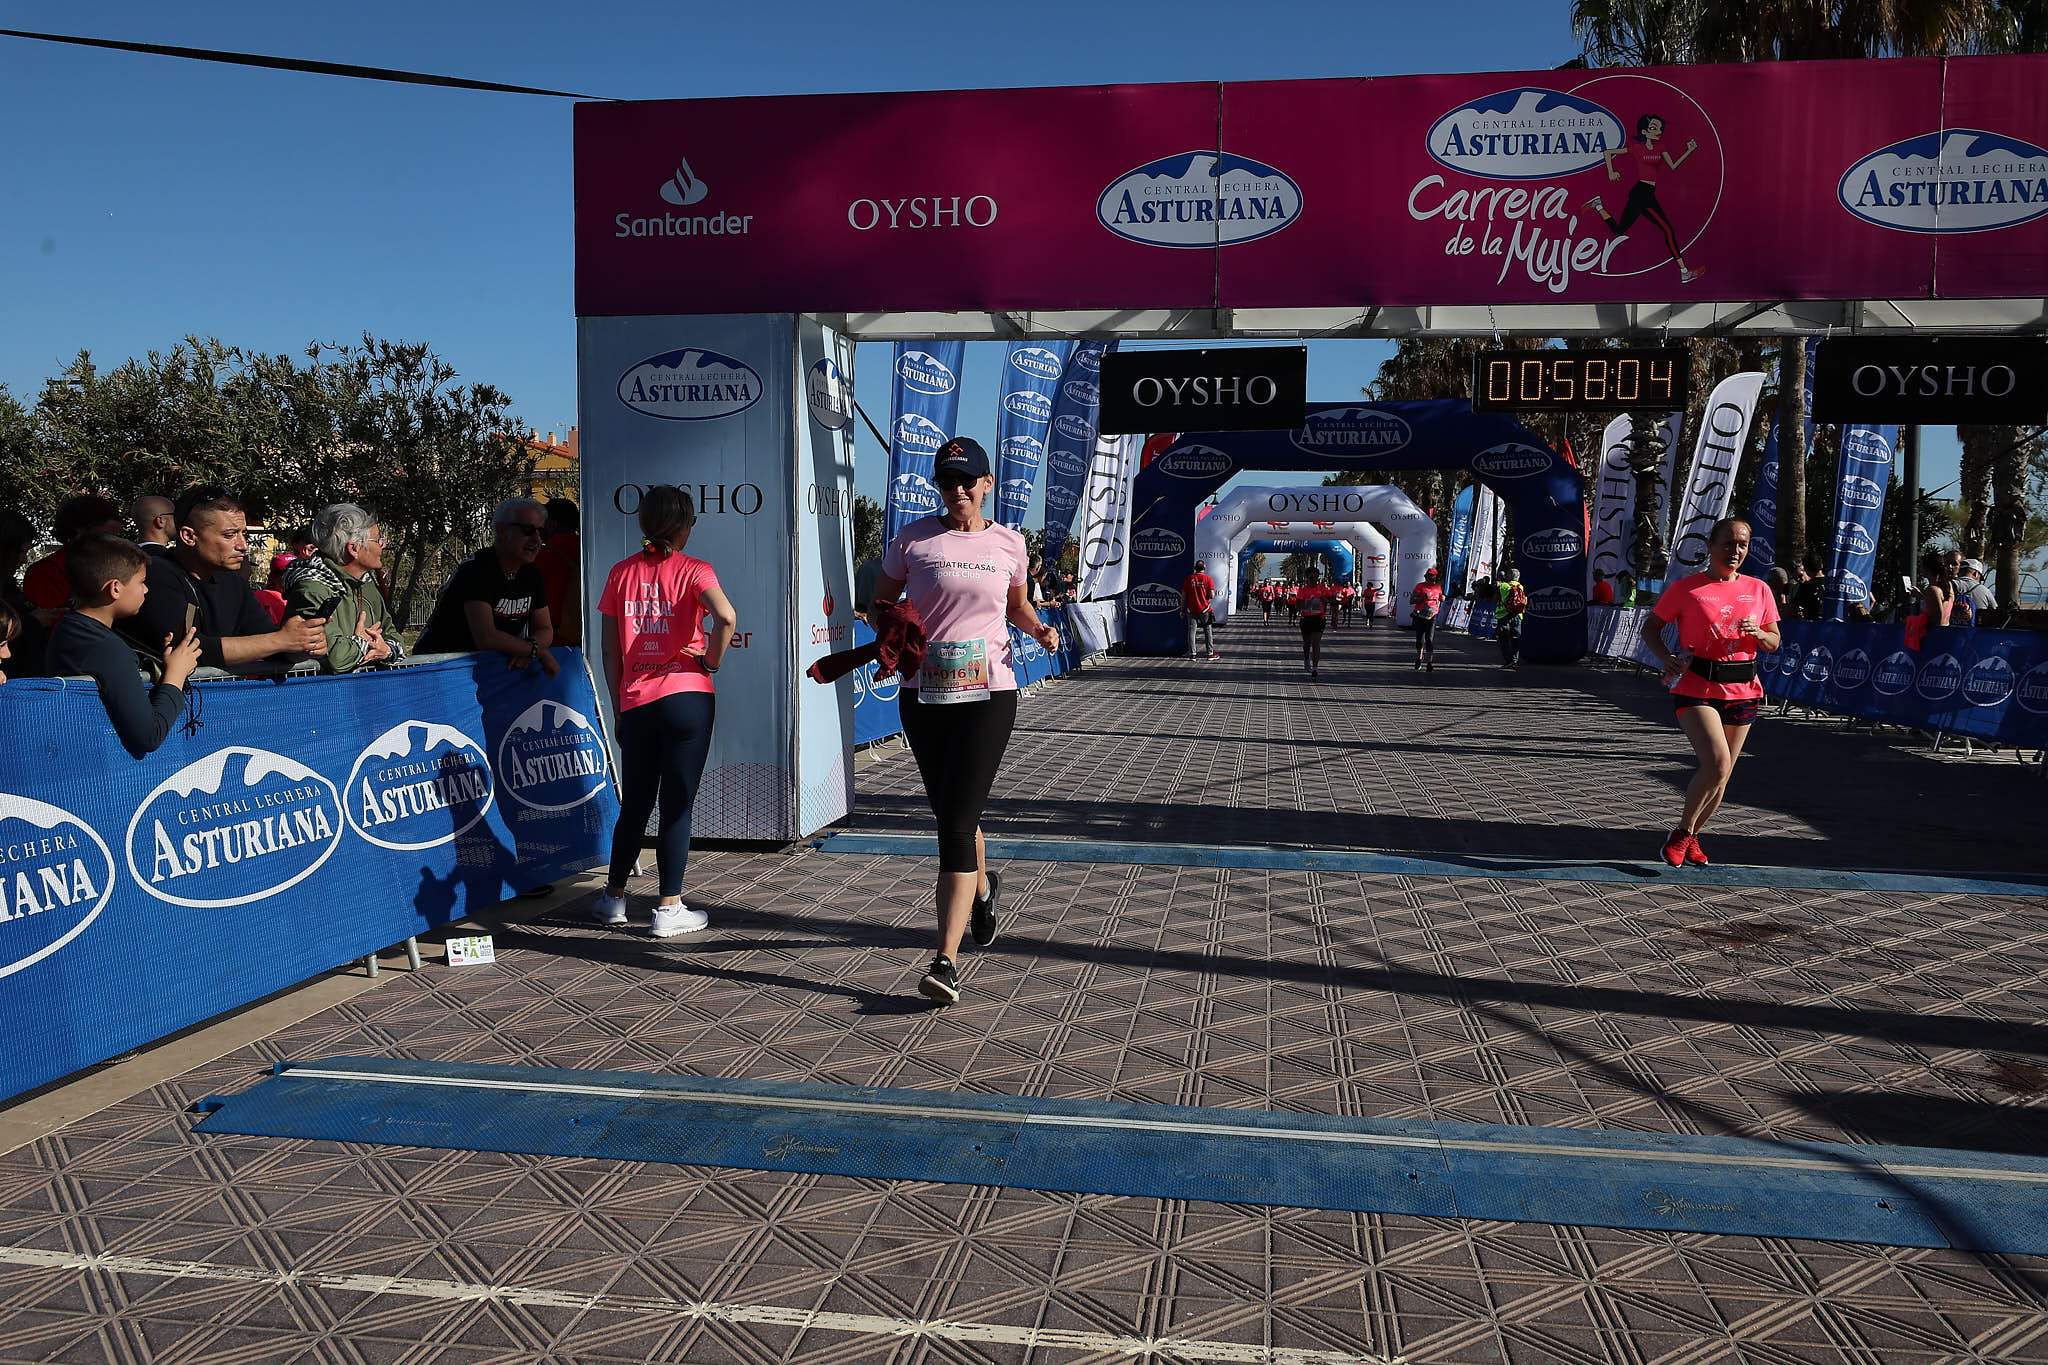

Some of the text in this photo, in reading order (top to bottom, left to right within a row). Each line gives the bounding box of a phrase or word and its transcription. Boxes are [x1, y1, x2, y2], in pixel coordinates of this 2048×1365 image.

[1472, 117, 1605, 129] CENTRAL LECHERA
[1440, 122, 1609, 157] ASTURIANA
[1893, 163, 2047, 176] CENTRAL LECHERA
[1144, 184, 1208, 195] CENTRAL
[1407, 174, 1569, 222] Carrera
[1855, 169, 2048, 207] ASTURIANA
[848, 194, 998, 231] OYSHO
[1112, 188, 1286, 224] ASTURIANA
[615, 211, 754, 238] Santander
[1445, 215, 1630, 293] de la Mujer
[628, 375, 753, 402] ASTURIANA
[1133, 375, 1277, 407] OYSHO
[1488, 359, 1673, 401] 00:58:04
[1852, 364, 2016, 397] OYSHO
[1298, 423, 1403, 445] ASTURIANA
[1163, 457, 1226, 471] ASTURIANA
[1479, 457, 1547, 470] ASTURIANA
[1675, 402, 1744, 566] OYSHO
[613, 484, 763, 515] OHO
[808, 483, 850, 519] OYSHO
[1268, 493, 1364, 513] OYSHO
[1390, 513, 1421, 521] OYSHO
[1132, 539, 1182, 552] ASTURIANA
[641, 582, 659, 599] TU
[1131, 594, 1179, 607] ASTURIANA
[624, 600, 675, 617] DORSAL
[632, 618, 670, 635] SUMA
[522, 733, 593, 752] CENTRAL LECHER
[378, 752, 477, 782] CENTRAL LECHERA
[178, 784, 322, 826] CENTRAL LECHERA
[362, 768, 489, 829] ASTURIANA
[150, 804, 334, 884] ASTURIANA
